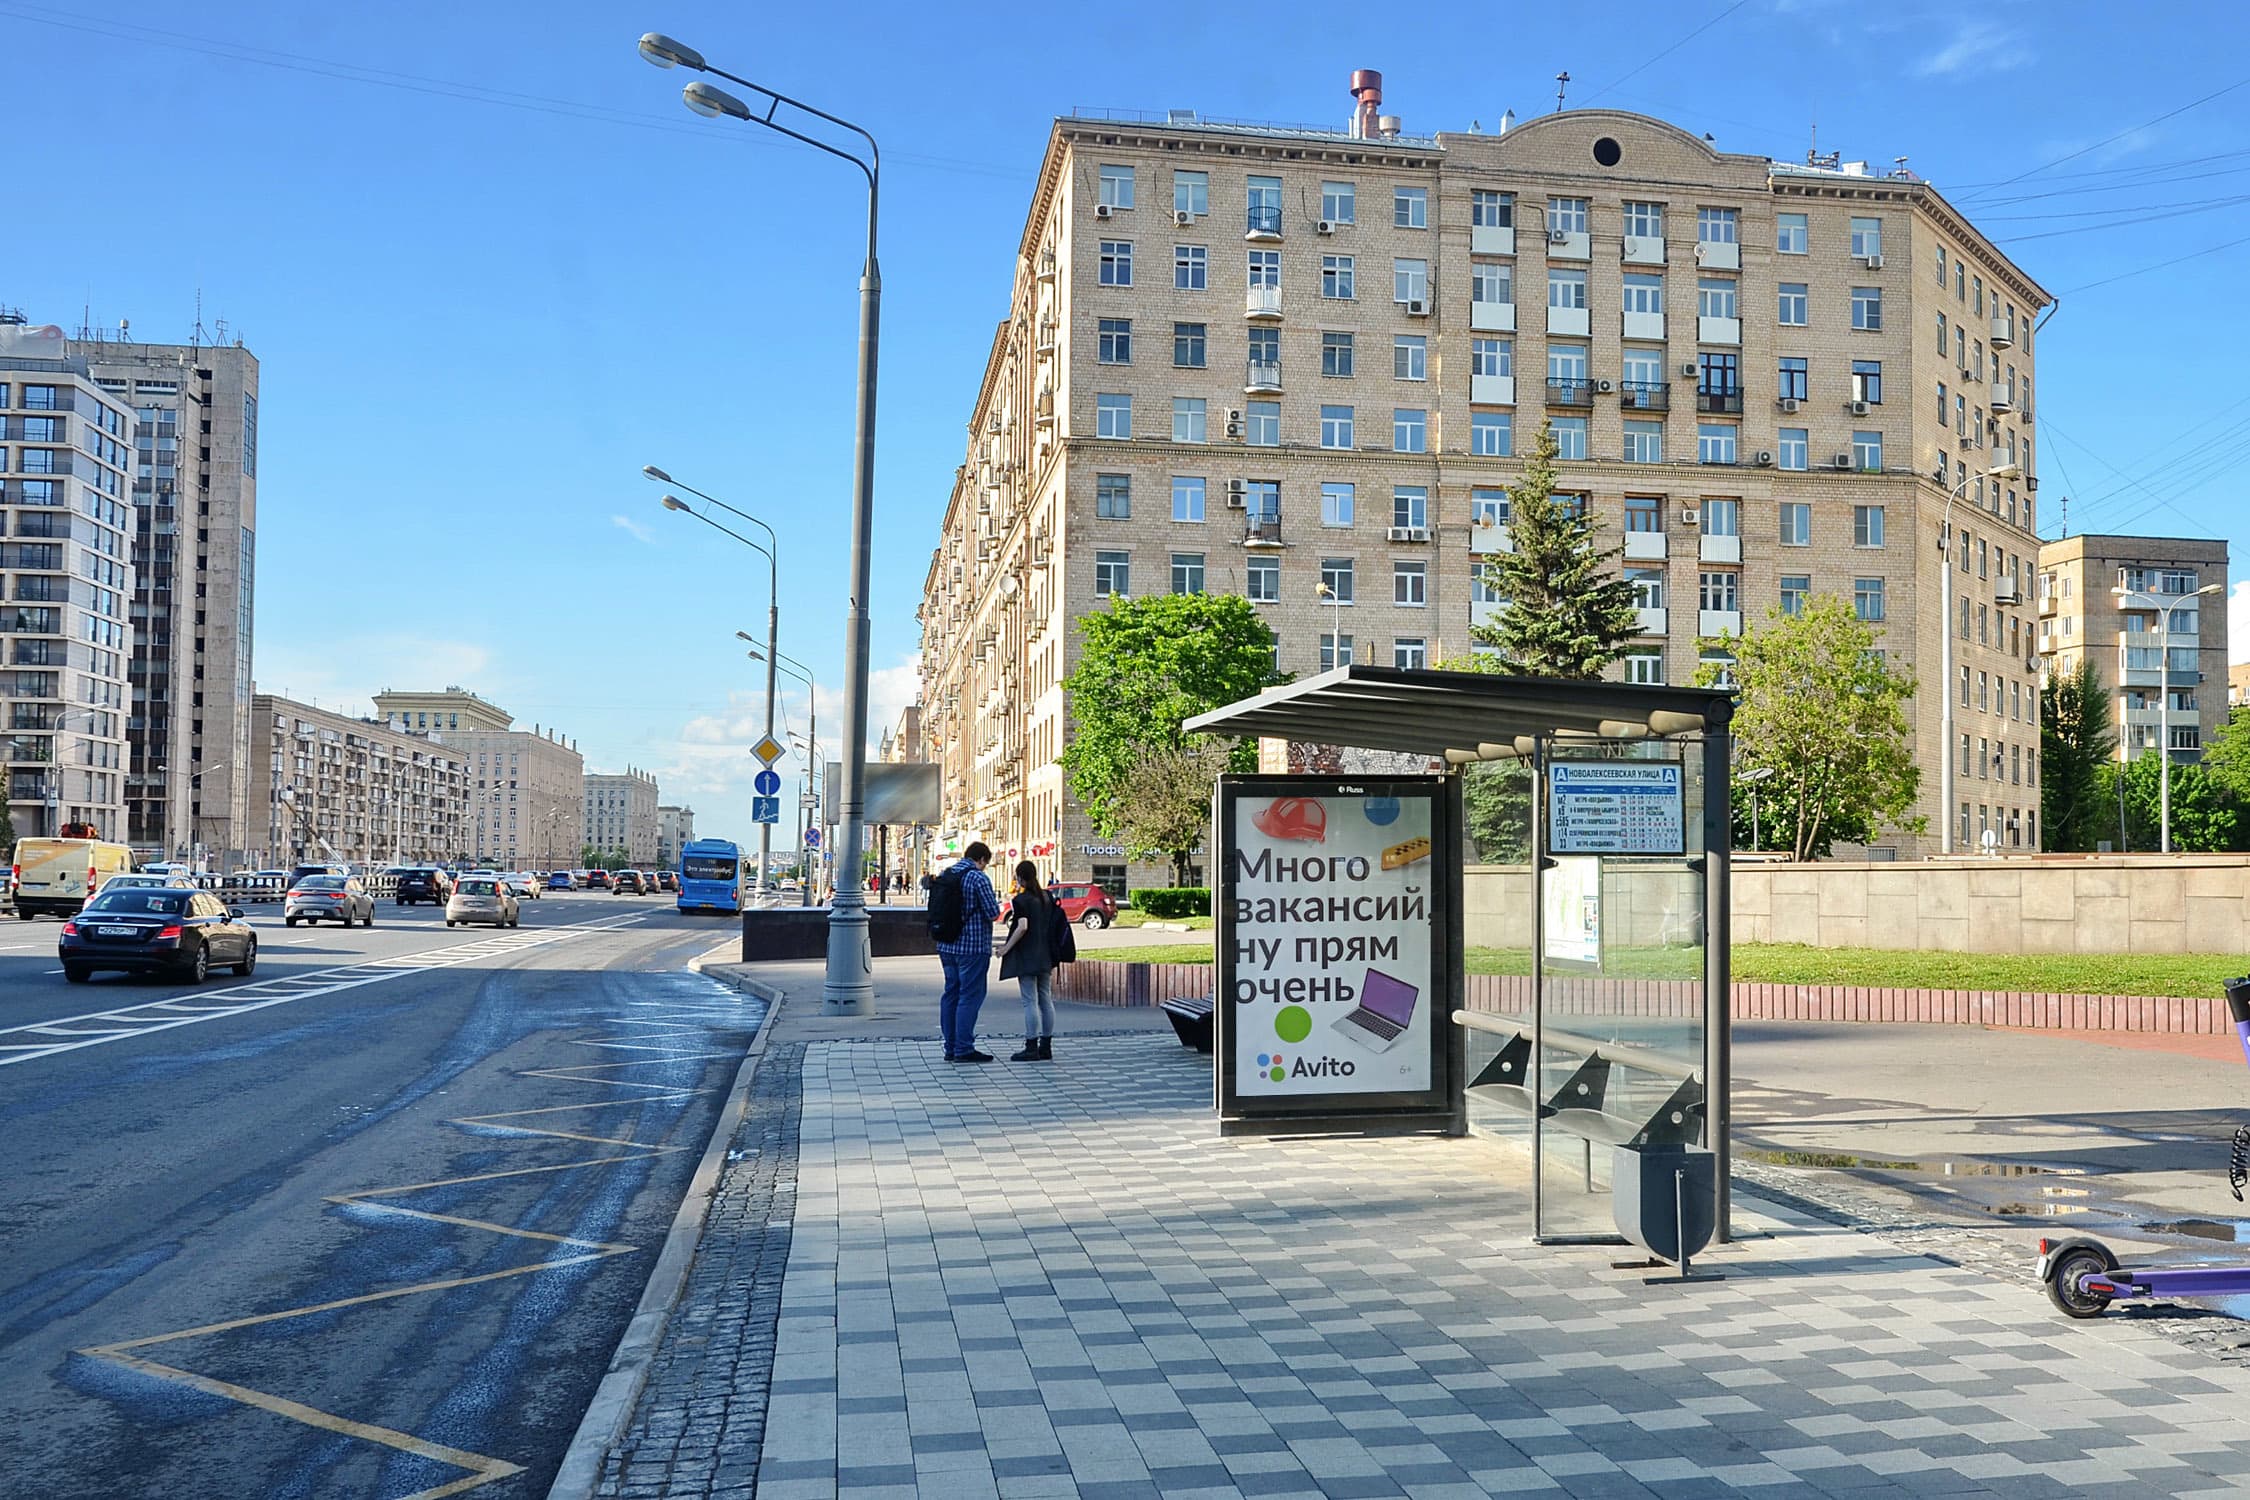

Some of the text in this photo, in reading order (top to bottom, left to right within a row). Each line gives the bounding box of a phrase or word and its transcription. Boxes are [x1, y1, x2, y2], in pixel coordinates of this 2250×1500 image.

[1569, 769, 1636, 778] НОВОАЛЕКСЕЕВСКАЯ
[1638, 770, 1660, 779] УЛИЦА
[1236, 849, 1370, 883] Много
[1236, 886, 1432, 926] вакансий,
[1236, 936, 1398, 971] ну прям
[1236, 977, 1354, 1004] очень
[1291, 1055, 1355, 1078] Avito
